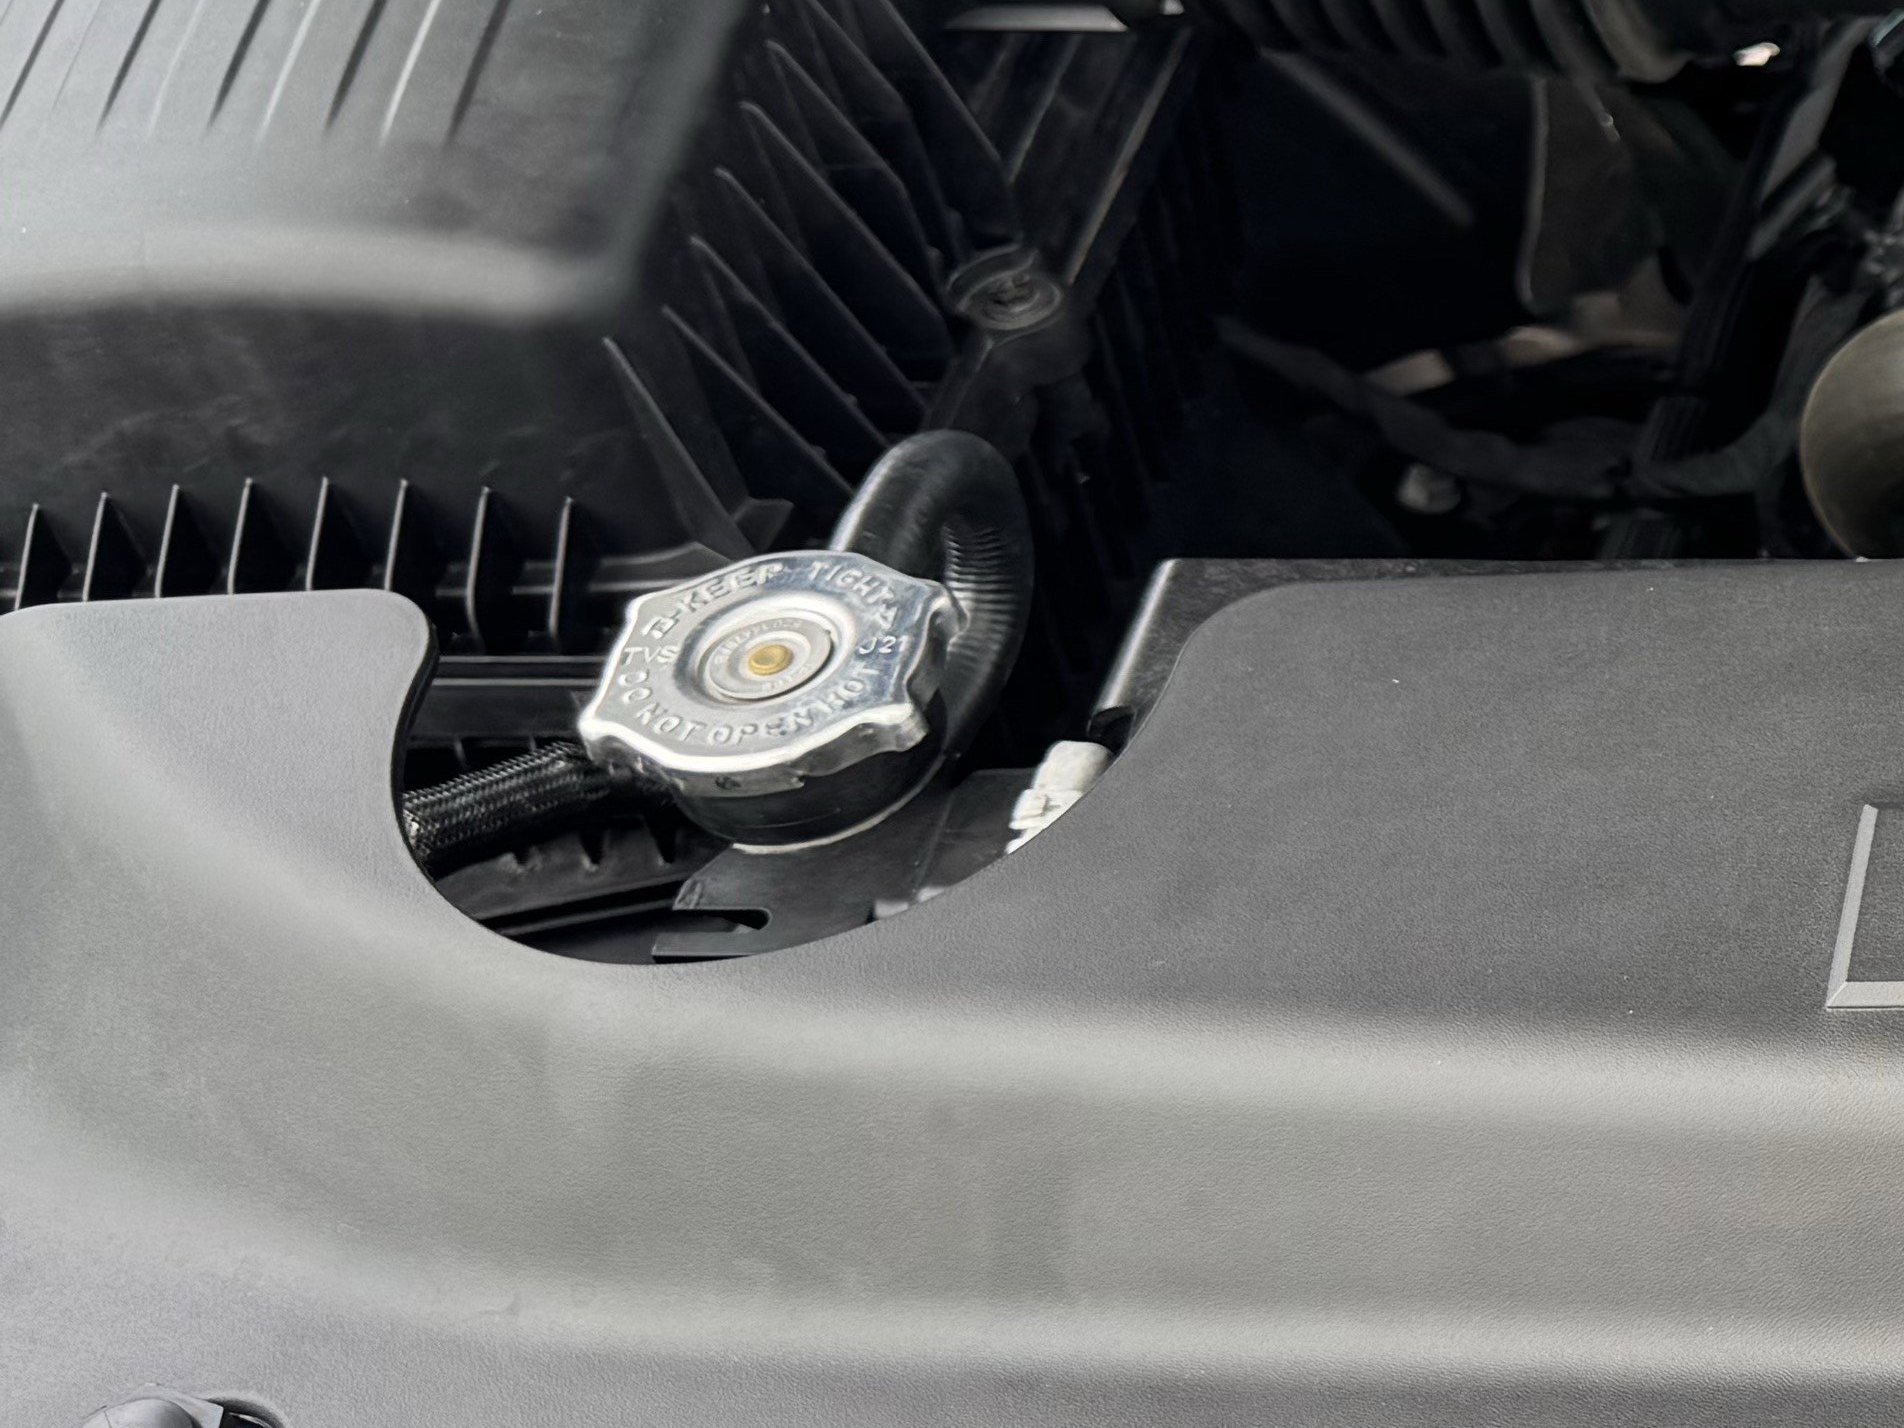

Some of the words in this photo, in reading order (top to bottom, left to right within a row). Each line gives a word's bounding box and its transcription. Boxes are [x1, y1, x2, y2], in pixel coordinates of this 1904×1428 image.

[683, 562, 785, 610] KEEP
[807, 560, 896, 604] TIGHT
[621, 644, 680, 666] TVS
[858, 634, 909, 655] J21
[617, 670, 653, 704] DO
[635, 701, 706, 742] NOT
[706, 706, 815, 747] OPEN
